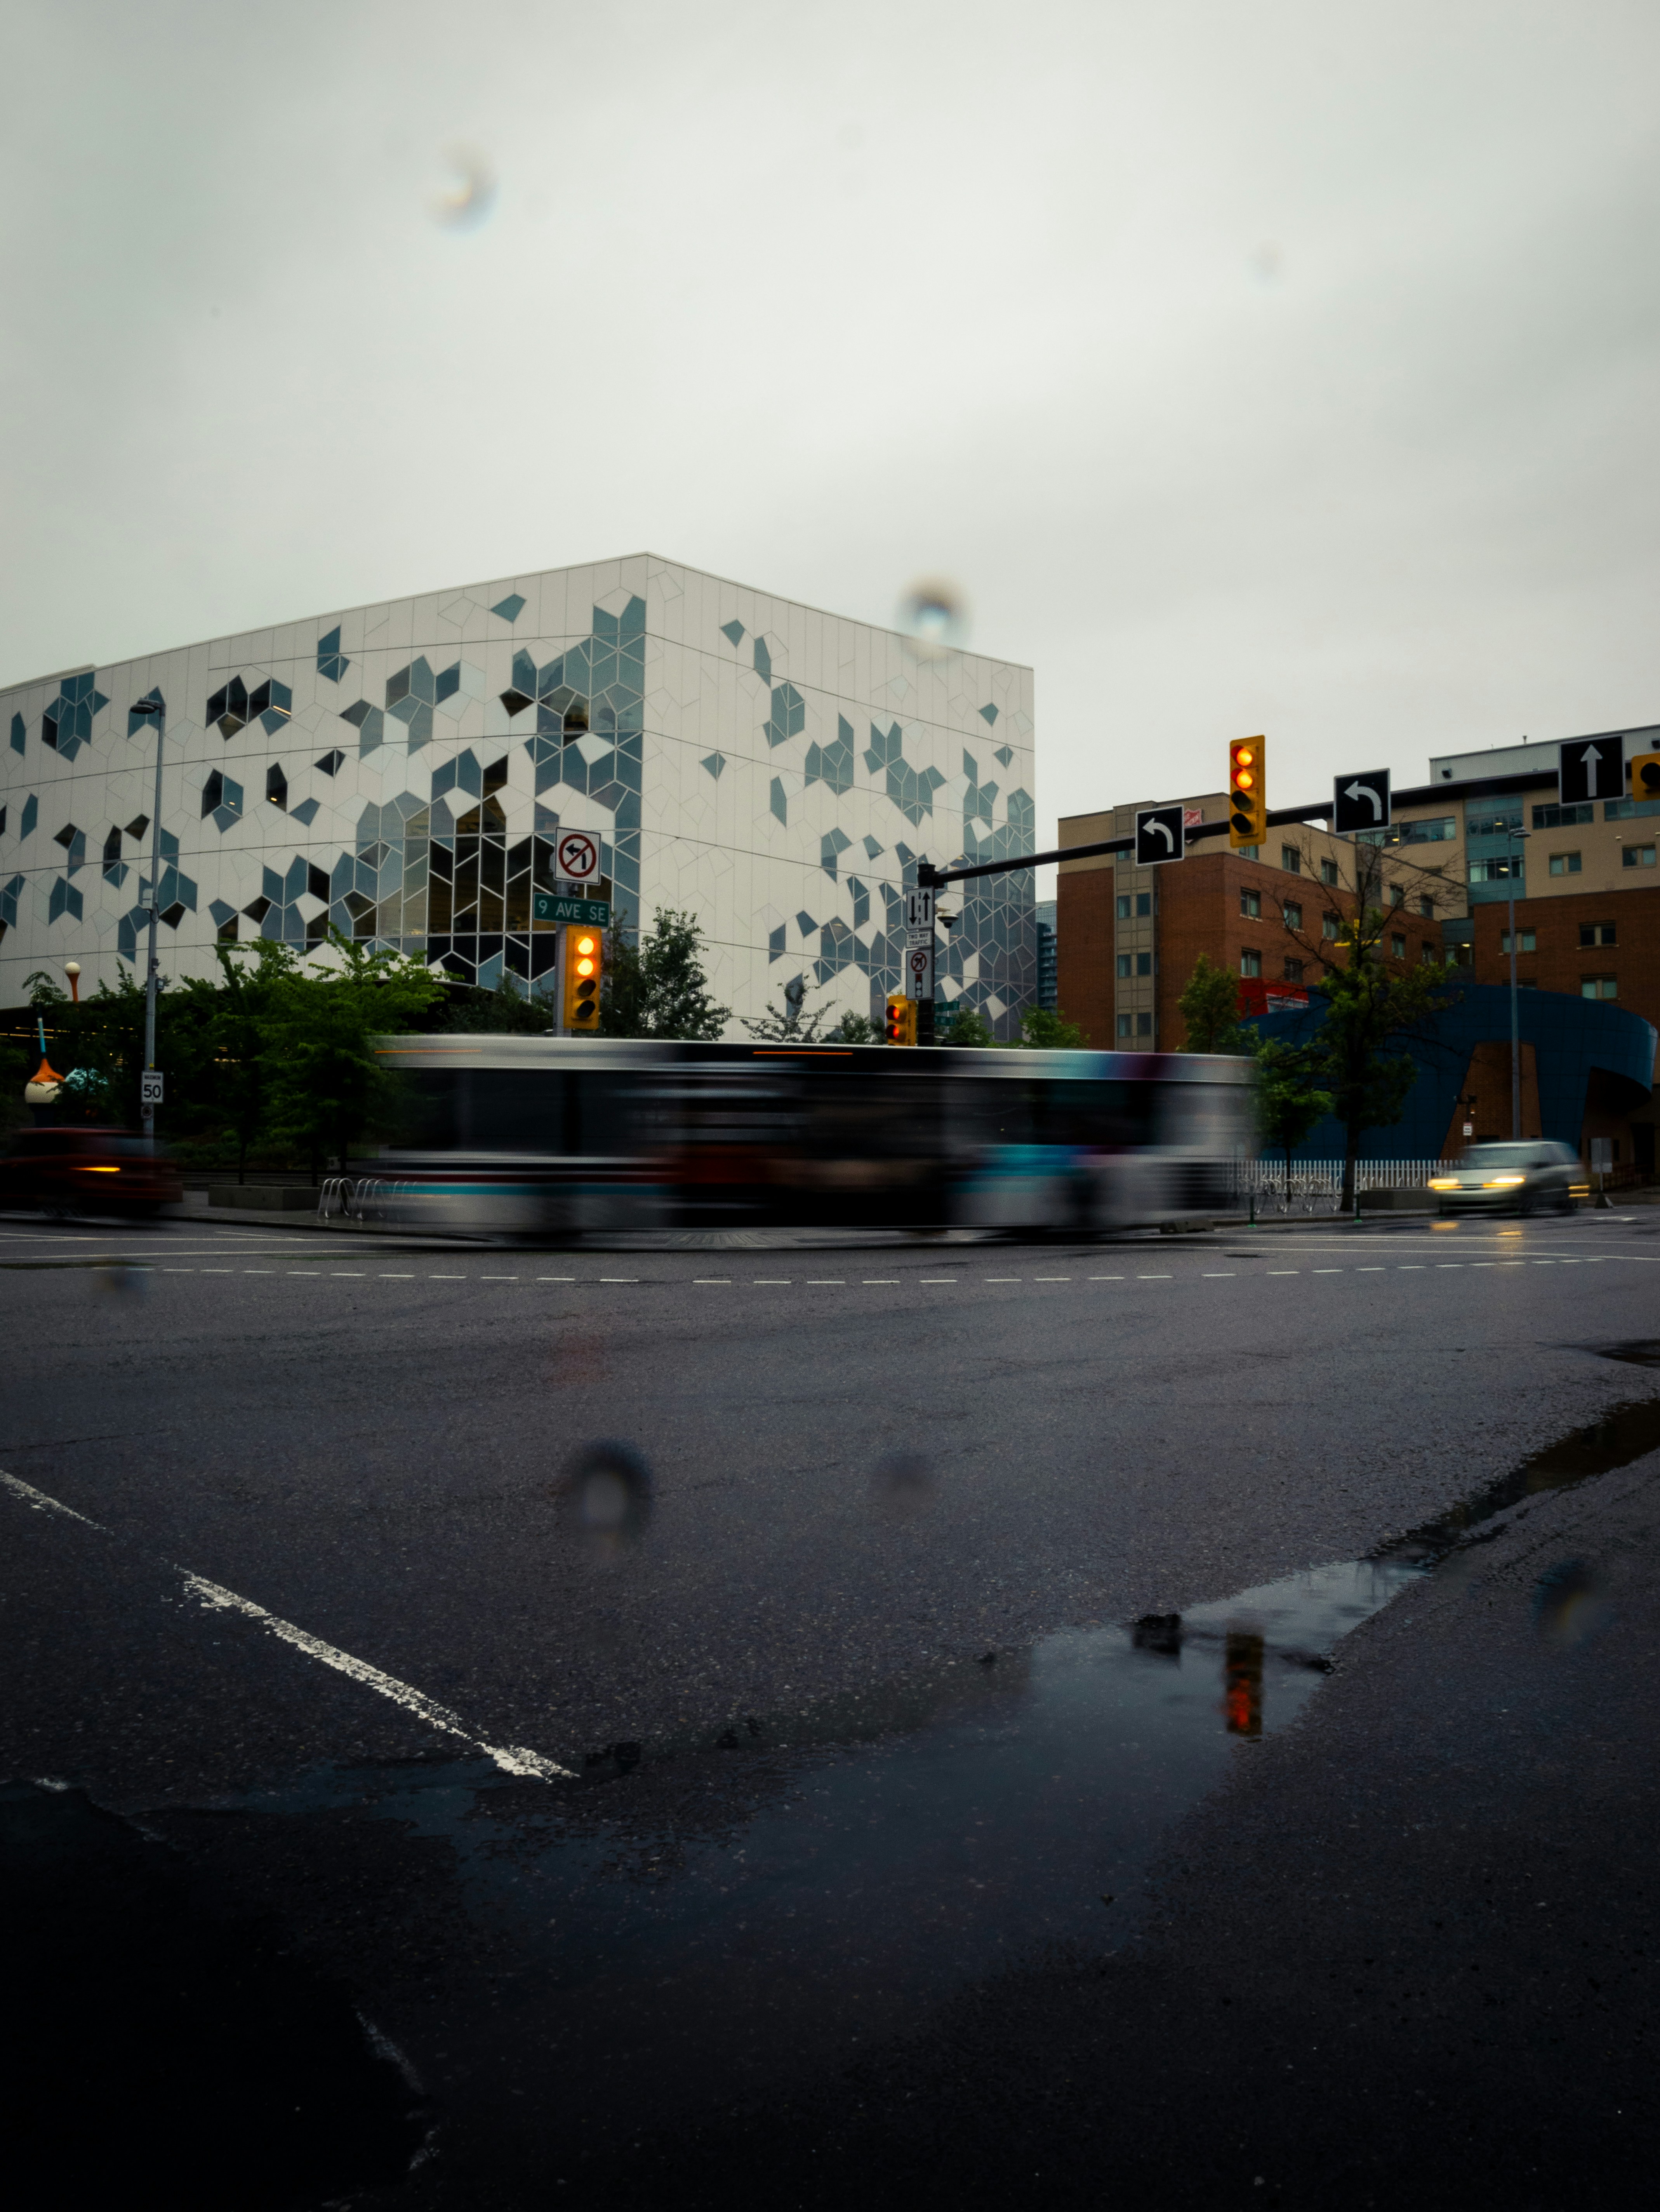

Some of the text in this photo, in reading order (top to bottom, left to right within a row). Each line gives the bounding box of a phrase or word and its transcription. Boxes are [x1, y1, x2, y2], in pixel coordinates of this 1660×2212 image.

[538, 899, 606, 922] 9 AVE SE
[144, 1084, 161, 1098] 50
